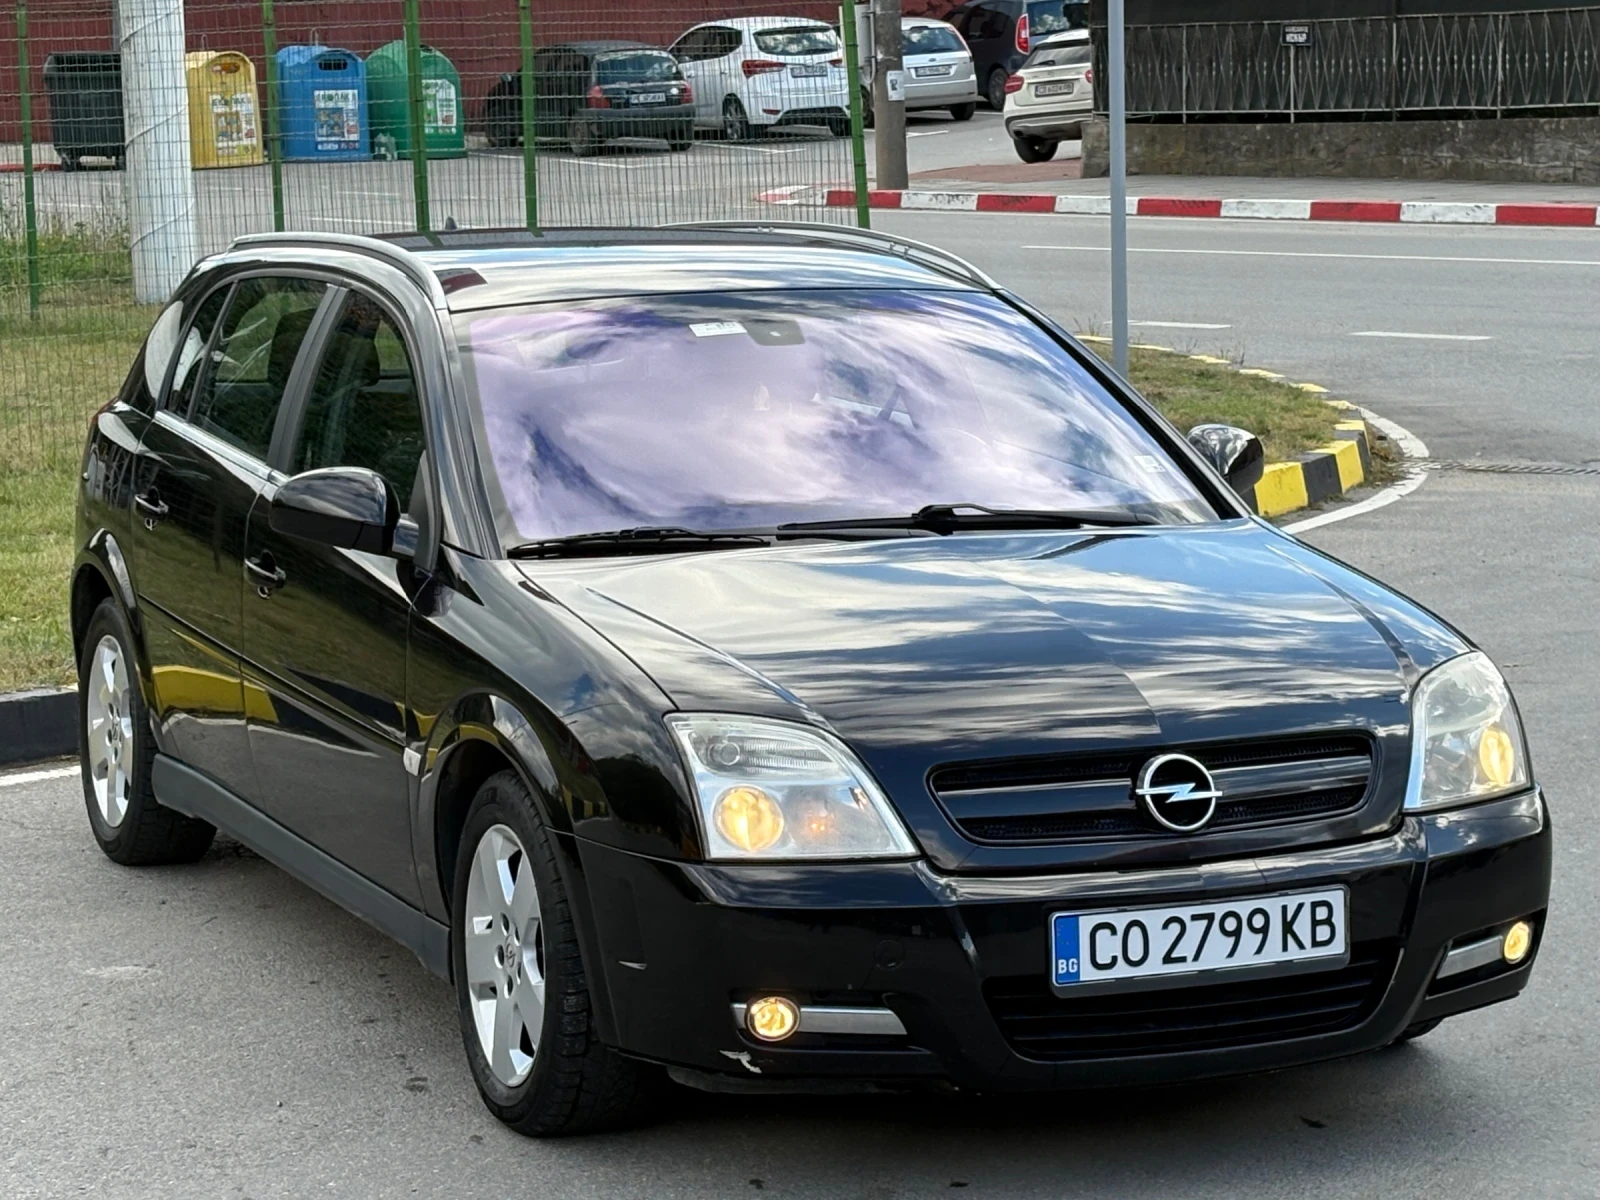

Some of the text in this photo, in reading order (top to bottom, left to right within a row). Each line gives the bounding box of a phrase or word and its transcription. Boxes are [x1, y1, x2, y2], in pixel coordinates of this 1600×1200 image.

[1089, 899, 1336, 971] CO 2799 KB
[1058, 959, 1078, 974] BG
